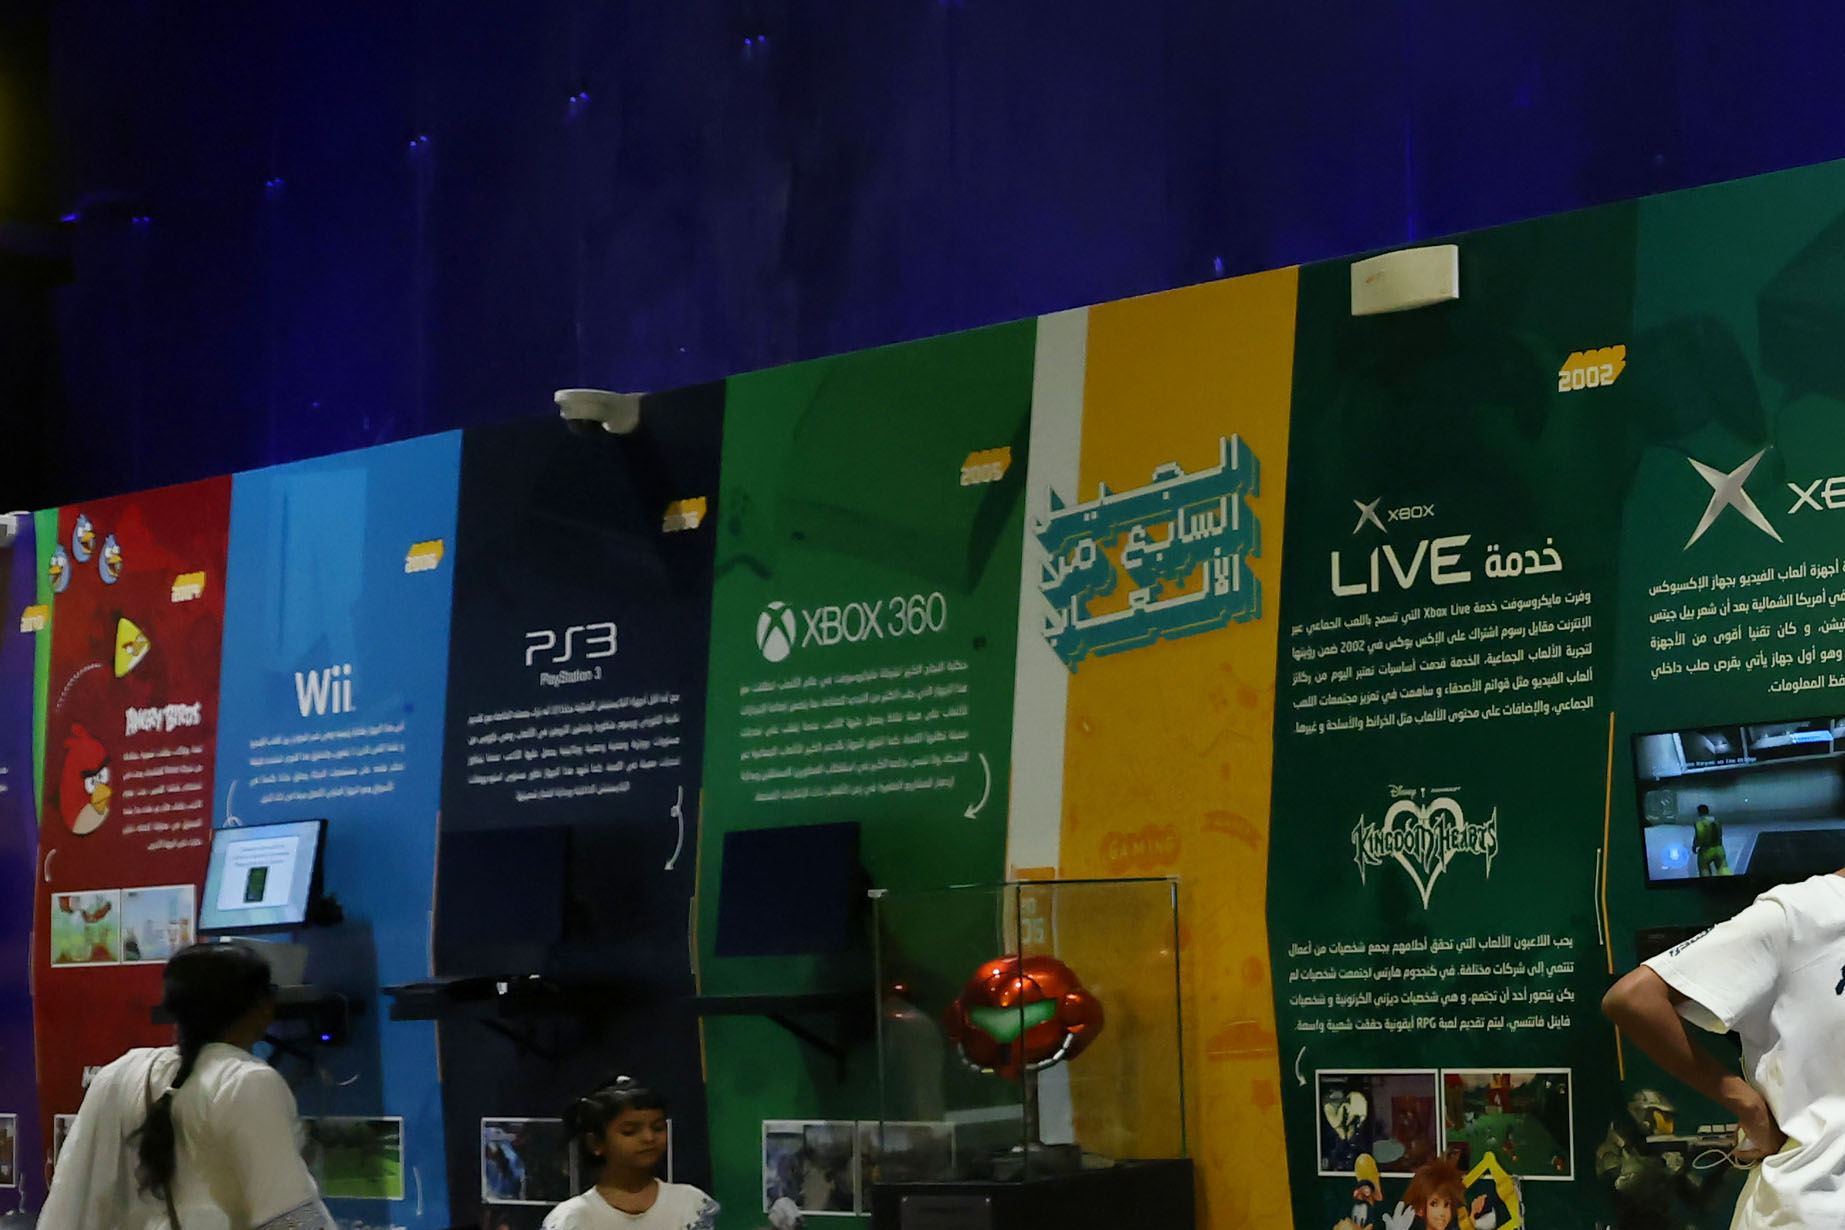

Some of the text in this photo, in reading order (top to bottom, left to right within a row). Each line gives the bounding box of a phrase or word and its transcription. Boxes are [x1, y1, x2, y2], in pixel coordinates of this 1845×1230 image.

[1557, 363, 1615, 393] 2002
[1036, 433, 1239, 533] الجيل
[1387, 503, 1435, 522] XBOX
[1037, 492, 1240, 592] السابع من
[1330, 533, 1563, 597] خدمة LIVE
[1041, 546, 1241, 648] الألعاب
[1719, 597, 1730, 616] أن
[1732, 601, 1749, 614] بعد
[1751, 593, 1793, 613] الشمالية
[1795, 586, 1826, 608] أمريكا
[801, 591, 948, 648] XBOX 360
[1649, 607, 1677, 624] جيتس
[1678, 604, 1694, 621] بيل
[1696, 601, 1717, 619] شعر
[524, 621, 618, 667] PS3
[593, 665, 603, 681] 3
[1767, 673, 1824, 694] المعلومات.
[294, 664, 352, 718] Wii
